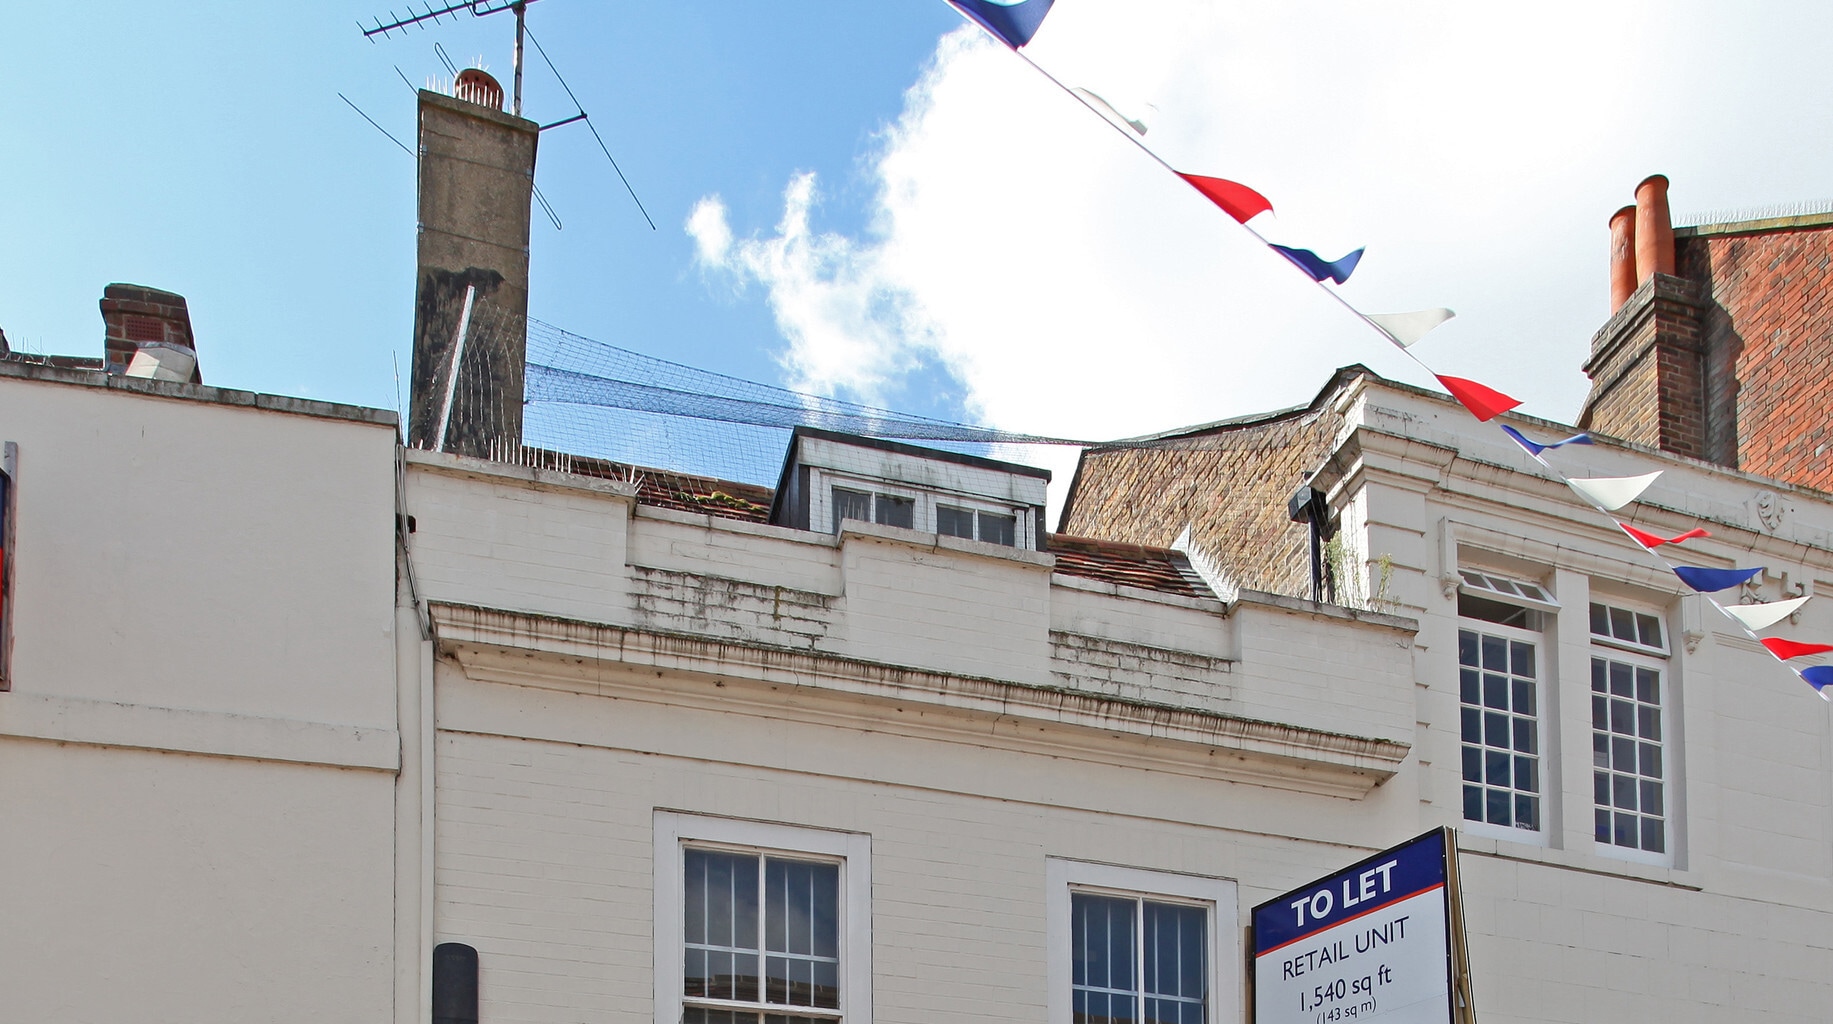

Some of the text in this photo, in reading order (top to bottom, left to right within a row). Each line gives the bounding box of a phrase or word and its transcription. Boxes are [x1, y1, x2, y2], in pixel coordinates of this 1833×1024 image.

[1291, 859, 1398, 927] TO LET
[1283, 915, 1409, 981] RETAIL UNIT
[1299, 965, 1392, 1013] 1,540 sq ft
[1345, 1006, 1358, 1021] sq
[1360, 996, 1377, 1013] m)
